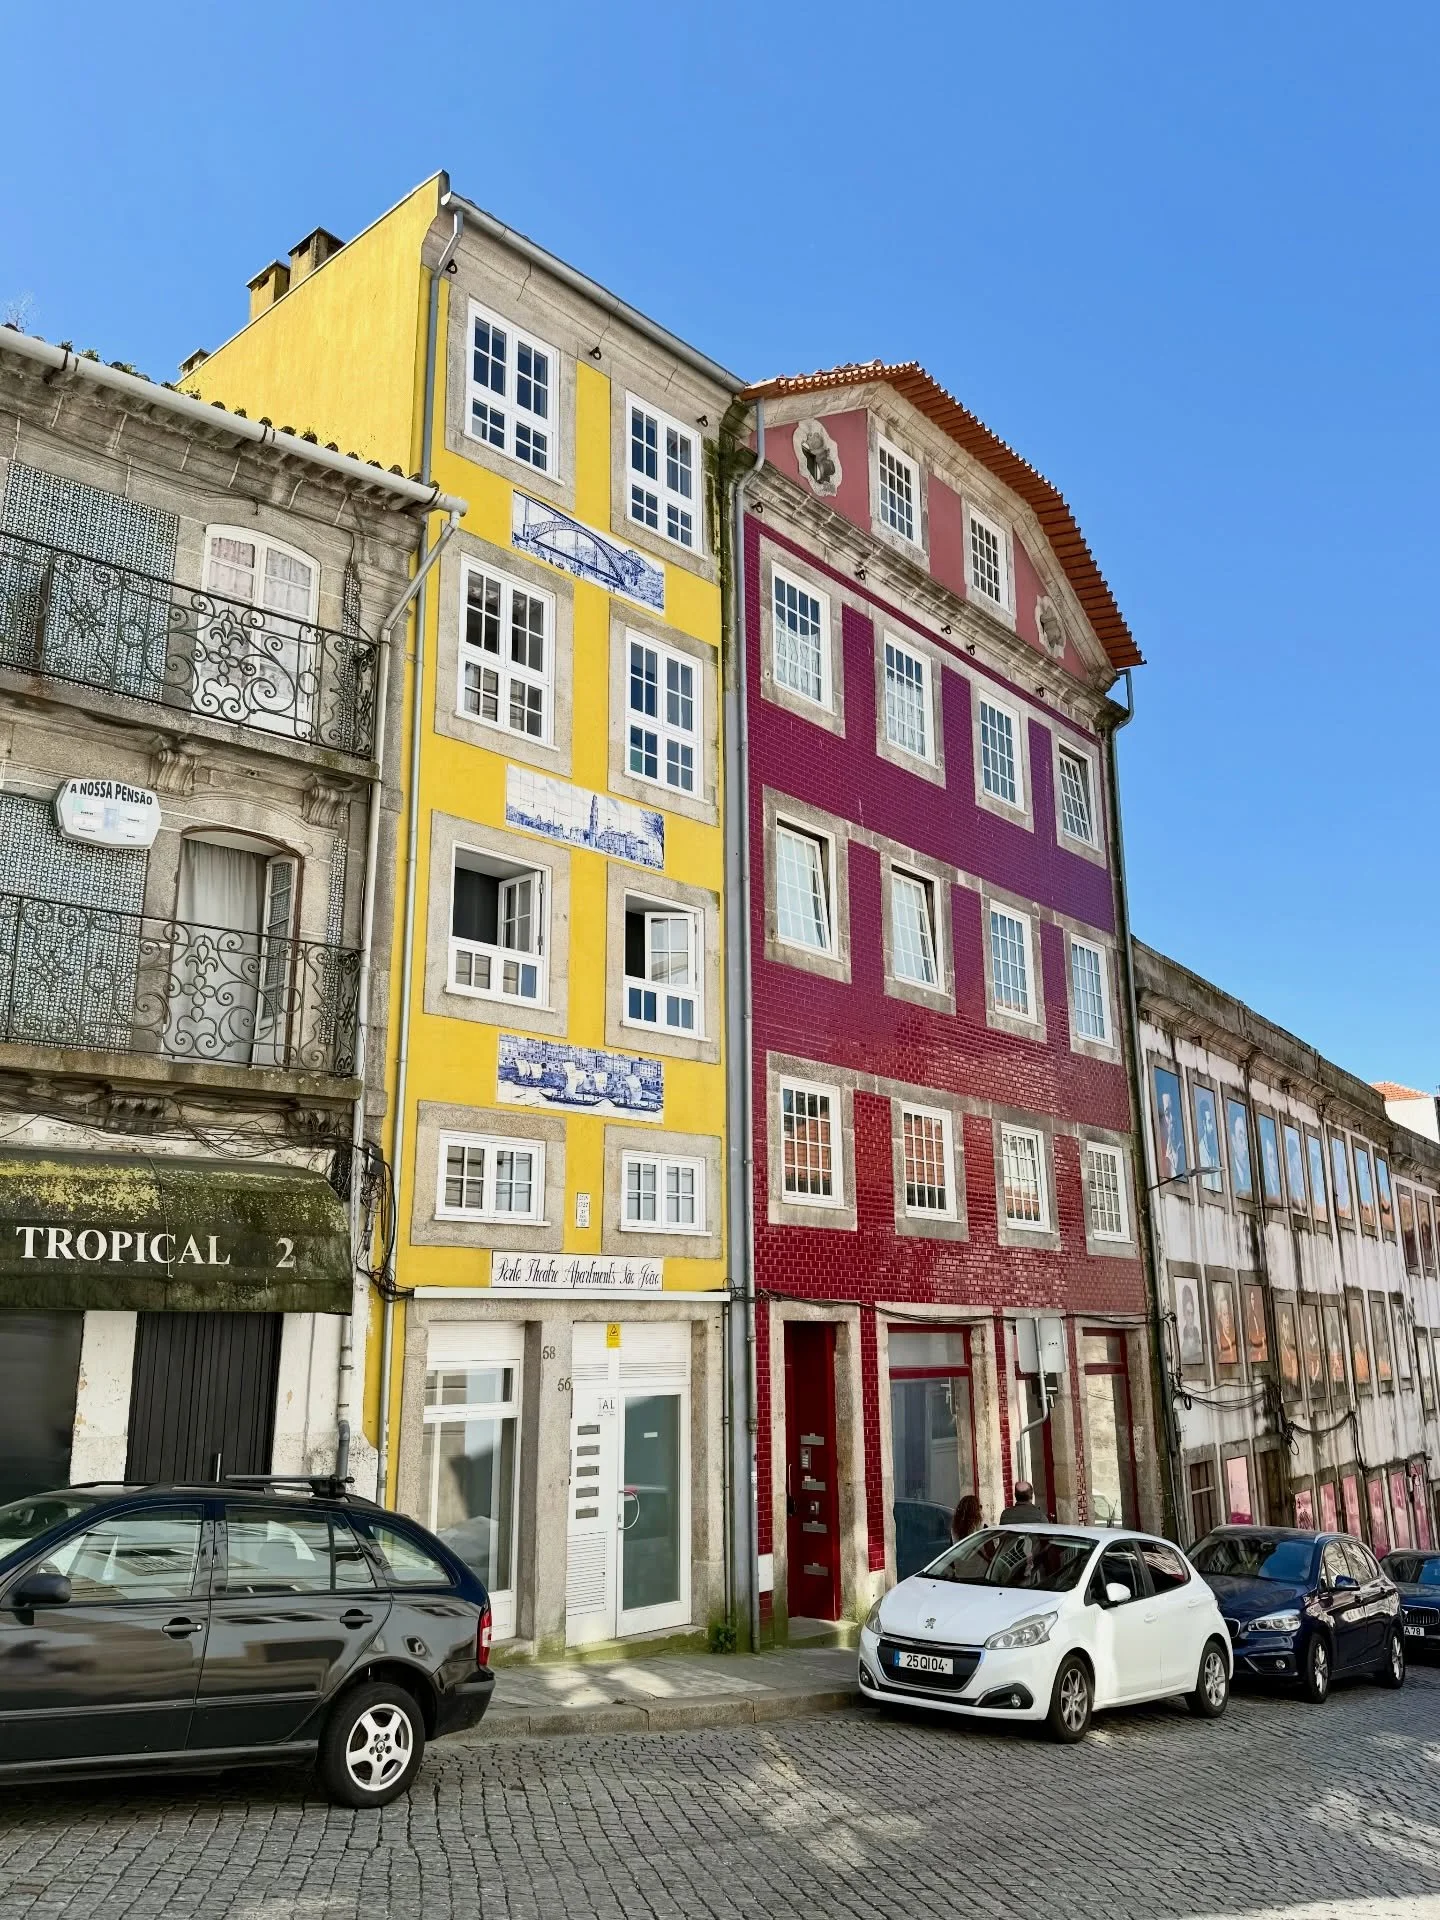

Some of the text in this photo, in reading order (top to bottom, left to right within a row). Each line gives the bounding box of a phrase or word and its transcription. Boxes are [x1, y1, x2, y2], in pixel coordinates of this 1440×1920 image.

[70, 781, 153, 805] A NOSSA PENSÃO
[16, 1226, 295, 1268] TROPICAL 2
[495, 1257, 660, 1289] Porto Theatre Apartments São João
[542, 1345, 556, 1359] 58
[557, 1377, 571, 1392] 56
